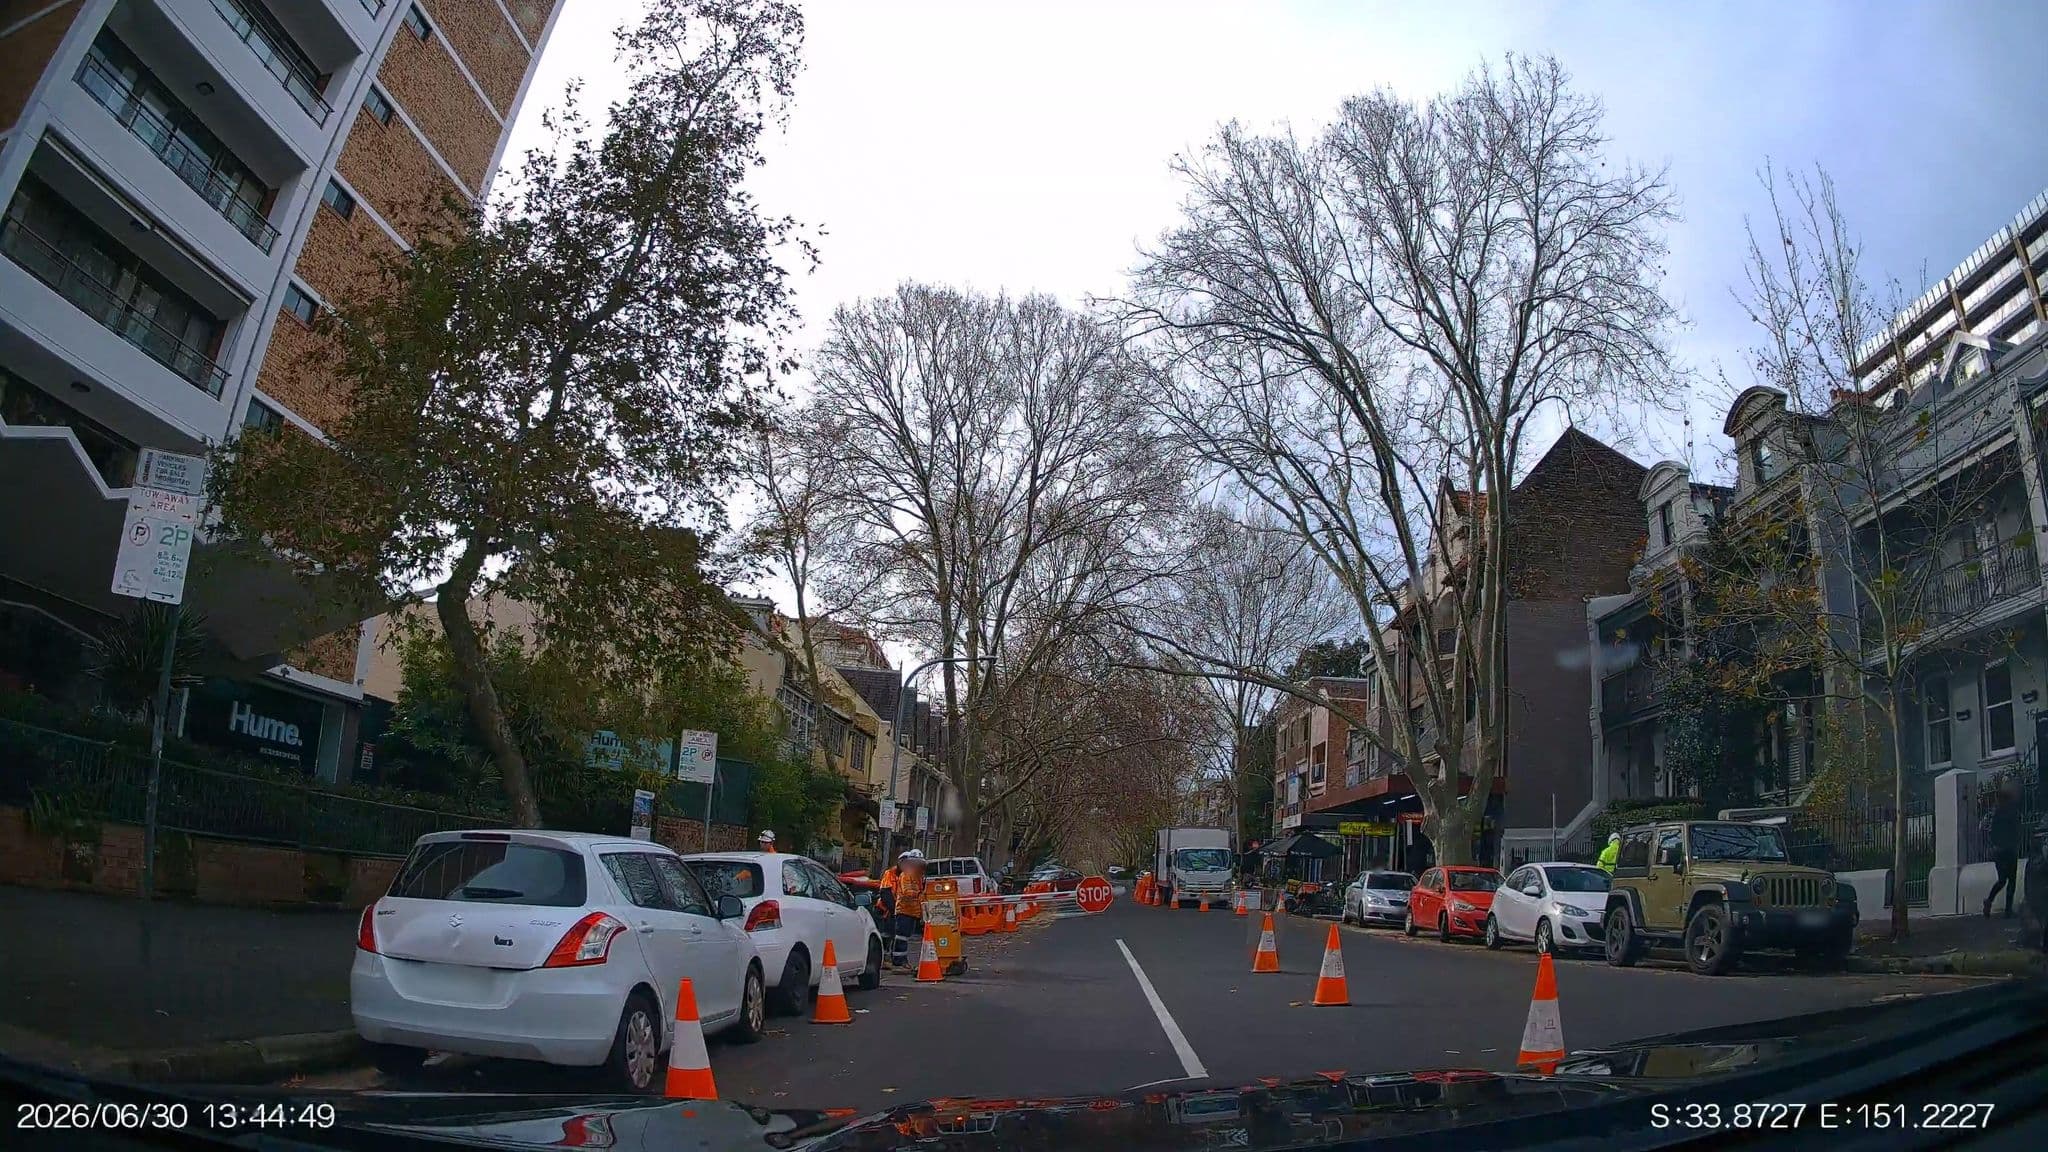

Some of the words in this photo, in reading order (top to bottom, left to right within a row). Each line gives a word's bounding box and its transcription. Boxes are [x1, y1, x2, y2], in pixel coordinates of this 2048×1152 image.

[140, 488, 160, 499] TOW
[164, 493, 190, 504] AWAY
[150, 501, 176, 513] AREA
[160, 527, 189, 546] 2P
[230, 700, 303, 747] Hume.
[591, 732, 624, 748] Hum
[682, 747, 697, 757] 2P
[1079, 886, 1110, 903] STOP
